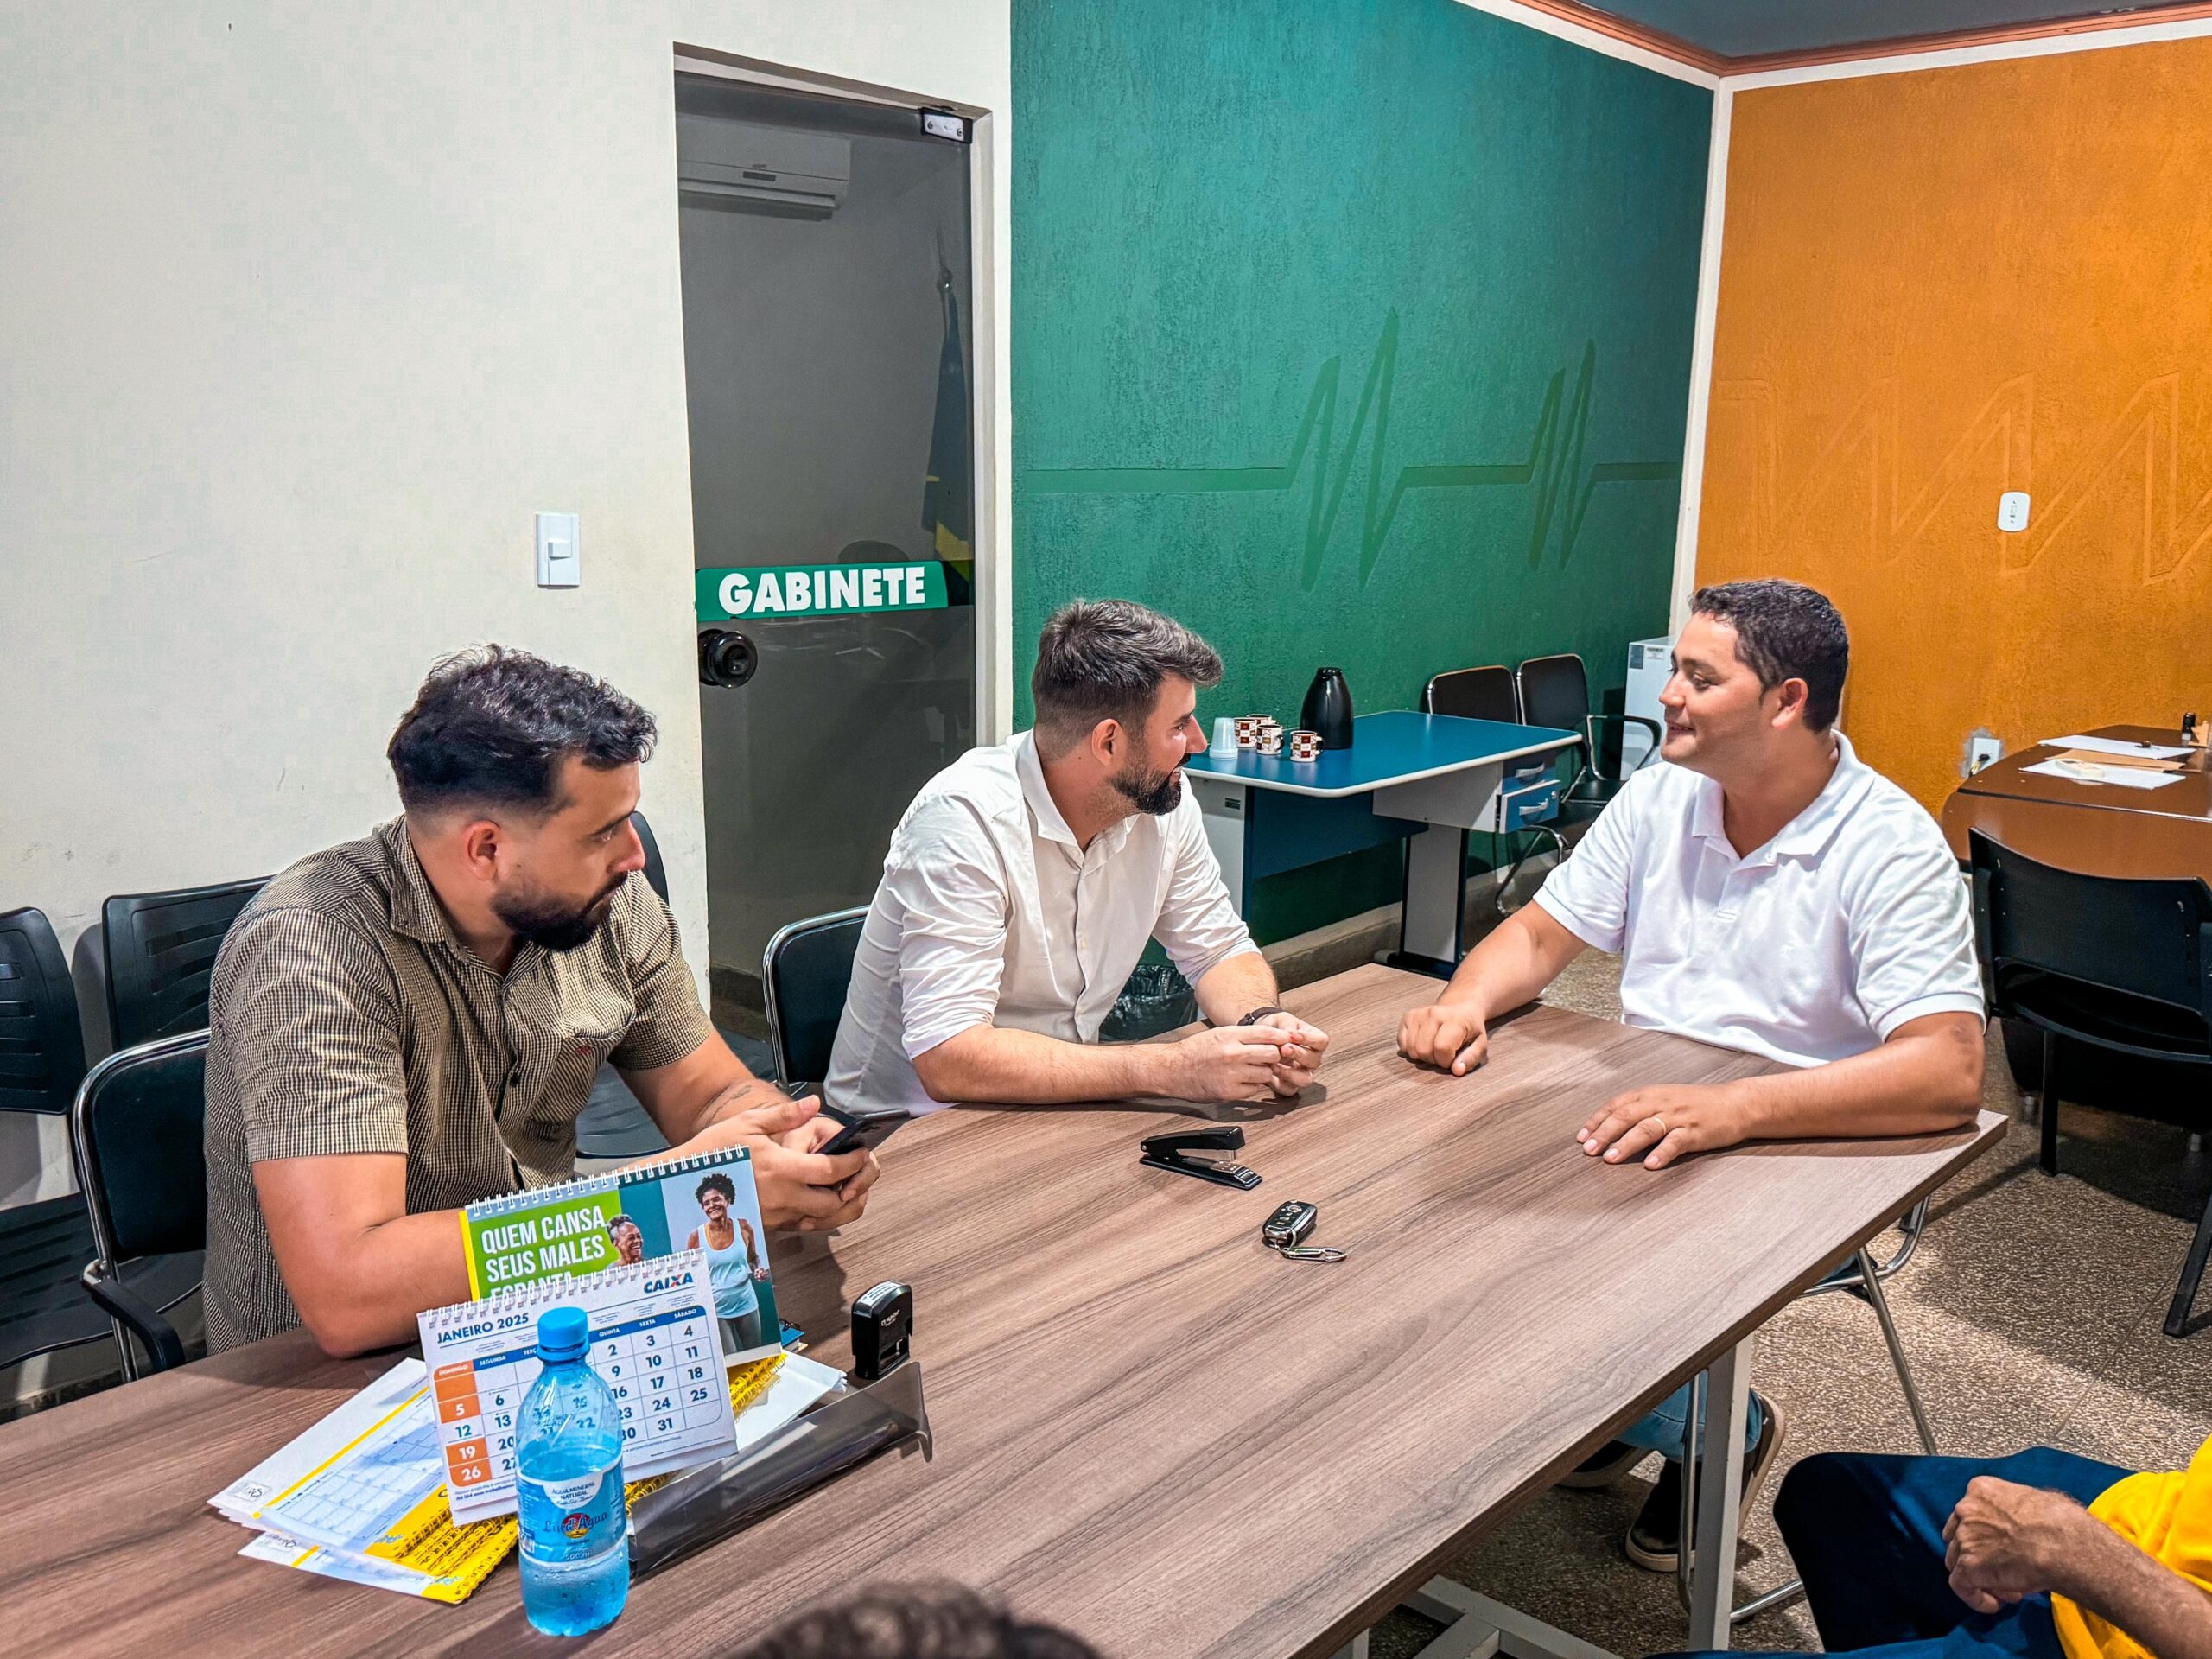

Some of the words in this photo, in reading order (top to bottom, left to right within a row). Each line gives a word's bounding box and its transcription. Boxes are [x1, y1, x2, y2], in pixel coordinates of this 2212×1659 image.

[718, 566, 925, 615] GABINETE
[481, 1220, 537, 1255] QUEM
[541, 1205, 606, 1241] CANSA
[486, 1250, 537, 1283] SEUS
[539, 1235, 606, 1271] MALES
[643, 1272, 694, 1294] CAIXA
[437, 1321, 493, 1344] JANEIRO
[497, 1313, 529, 1330] 2025
[479, 1355, 506, 1366] SEGUNDA
[598, 1327, 620, 1338] QUINTA
[639, 1319, 656, 1327] SEXTA
[673, 1307, 697, 1319] SÁBADO
[607, 1344, 618, 1357] 2
[645, 1334, 656, 1347] 3
[683, 1325, 694, 1338] 4
[455, 1403, 465, 1417] 5
[495, 1394, 505, 1407] 6
[611, 1364, 620, 1377] 9
[645, 1354, 662, 1369] 10
[685, 1345, 698, 1359] 11
[455, 1424, 472, 1439] 12
[495, 1414, 512, 1428] 13
[612, 1386, 628, 1399] 16
[650, 1376, 664, 1389] 17
[687, 1366, 703, 1380] 18
[459, 1446, 476, 1460] 19
[498, 1436, 514, 1451] 20
[652, 1396, 671, 1412] 24
[690, 1387, 708, 1402] 25
[461, 1466, 482, 1481] 26
[658, 1417, 673, 1431] 31
[560, 1491, 588, 1500] NATURAL
[569, 1482, 595, 1492] MINERAL
